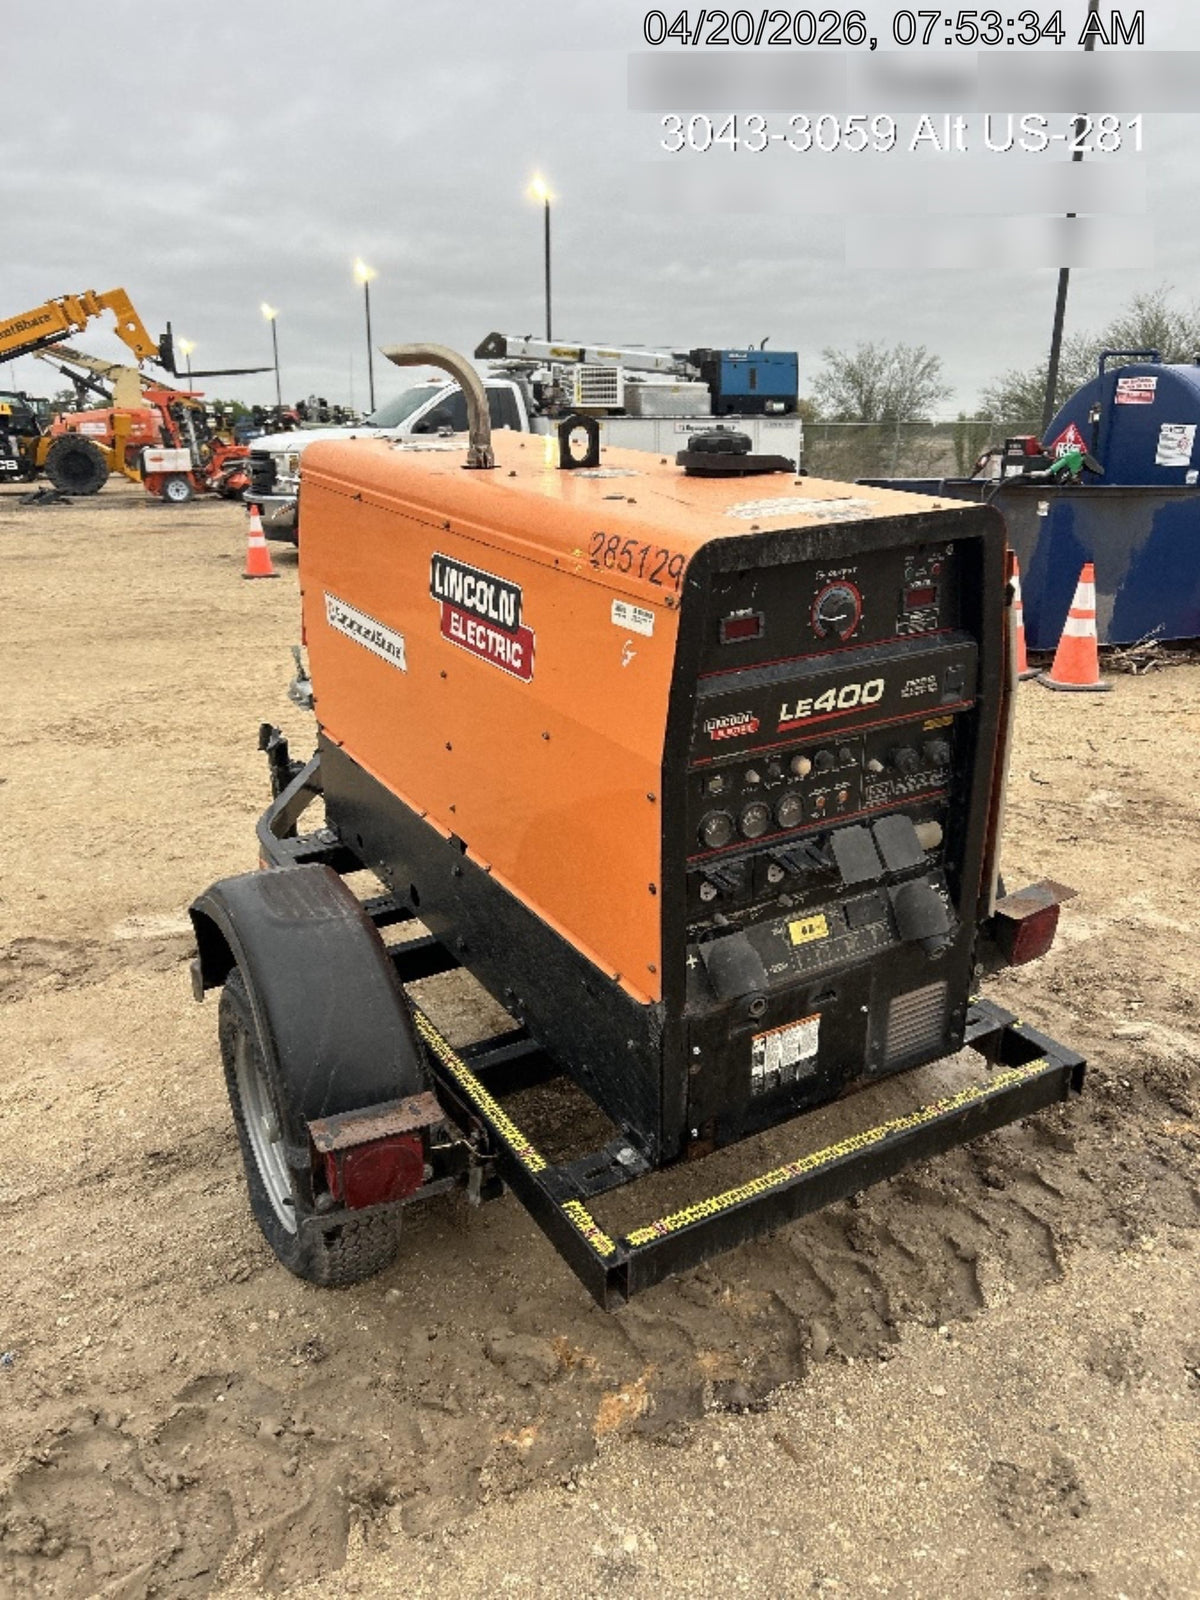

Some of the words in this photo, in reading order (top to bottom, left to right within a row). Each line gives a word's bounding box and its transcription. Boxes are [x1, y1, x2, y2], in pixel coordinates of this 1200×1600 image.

[589, 531, 685, 593] 285129
[434, 562, 516, 627] LINCOLN
[449, 611, 523, 669] ELECTRIC
[779, 678, 885, 722] LE400
